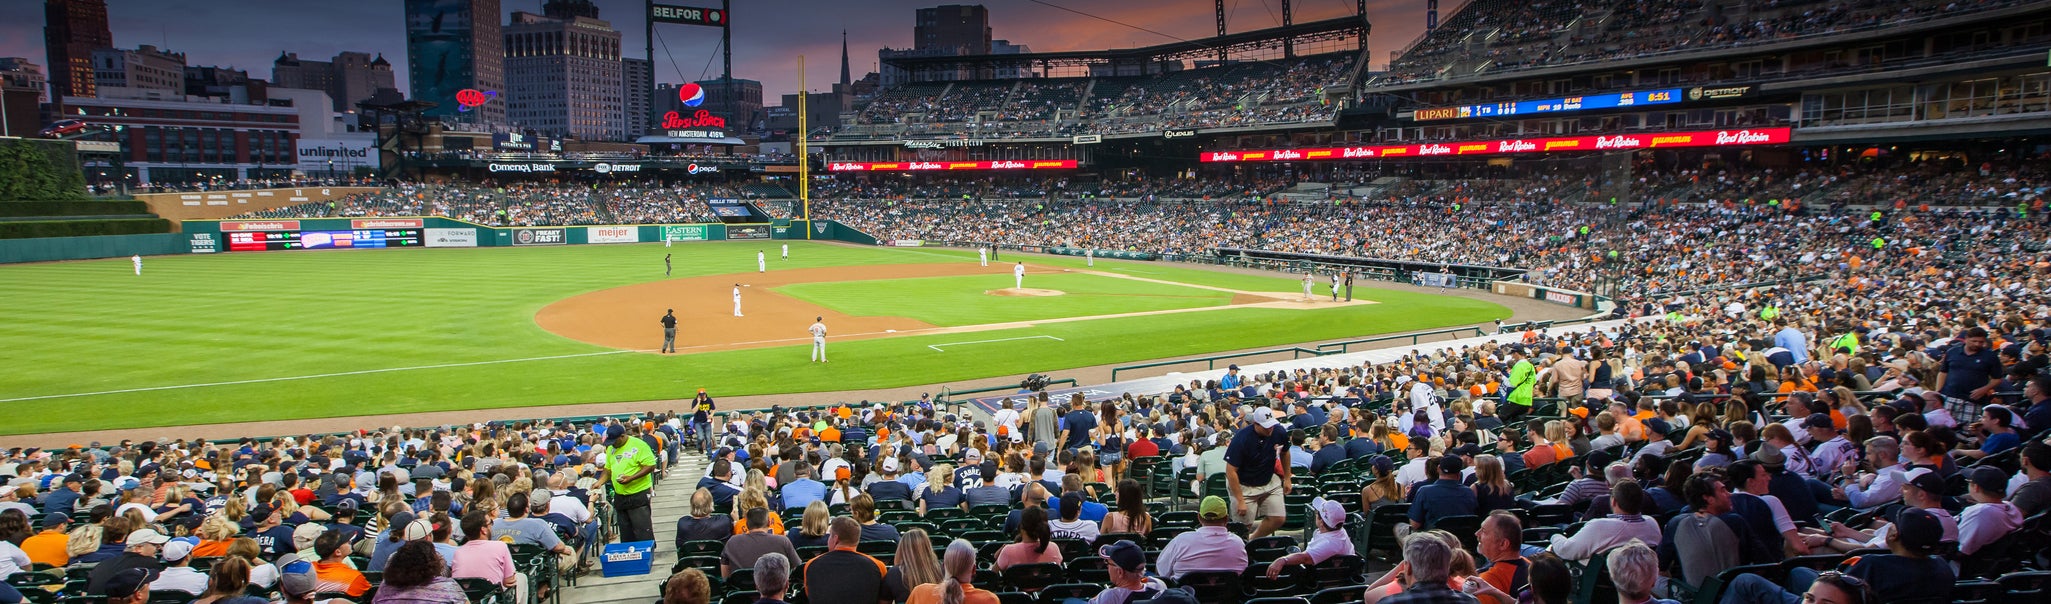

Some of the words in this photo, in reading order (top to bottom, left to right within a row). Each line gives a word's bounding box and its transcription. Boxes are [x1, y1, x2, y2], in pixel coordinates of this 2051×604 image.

[653, 6, 701, 20] BELFOR
[1704, 86, 1750, 96] DETROIT
[460, 92, 483, 105] AAA
[1648, 92, 1670, 101] 8:51
[662, 110, 692, 129] PEPSI
[693, 110, 725, 128] PORCH
[1420, 110, 1452, 119] LIPARI
[509, 132, 523, 142] Lite
[1596, 136, 1613, 148] Red
[1613, 135, 1640, 148] Robin
[1650, 135, 1692, 148] yummm
[1716, 131, 1737, 144] Red
[1738, 130, 1769, 143] Robin
[1419, 145, 1432, 154] Red
[1432, 144, 1450, 154] Robin
[1458, 144, 1487, 154] yummm
[1499, 141, 1514, 152] Red
[1514, 140, 1535, 150] Robin
[1545, 140, 1579, 151] yummm
[300, 146, 366, 158] unlimited
[1274, 151, 1284, 159] Red
[1344, 149, 1356, 157] Red
[1356, 148, 1374, 156] Robin
[1381, 147, 1406, 157] yummm
[532, 163, 556, 172] Bank
[599, 227, 628, 237] meijer
[960, 467, 981, 478] CABRE
